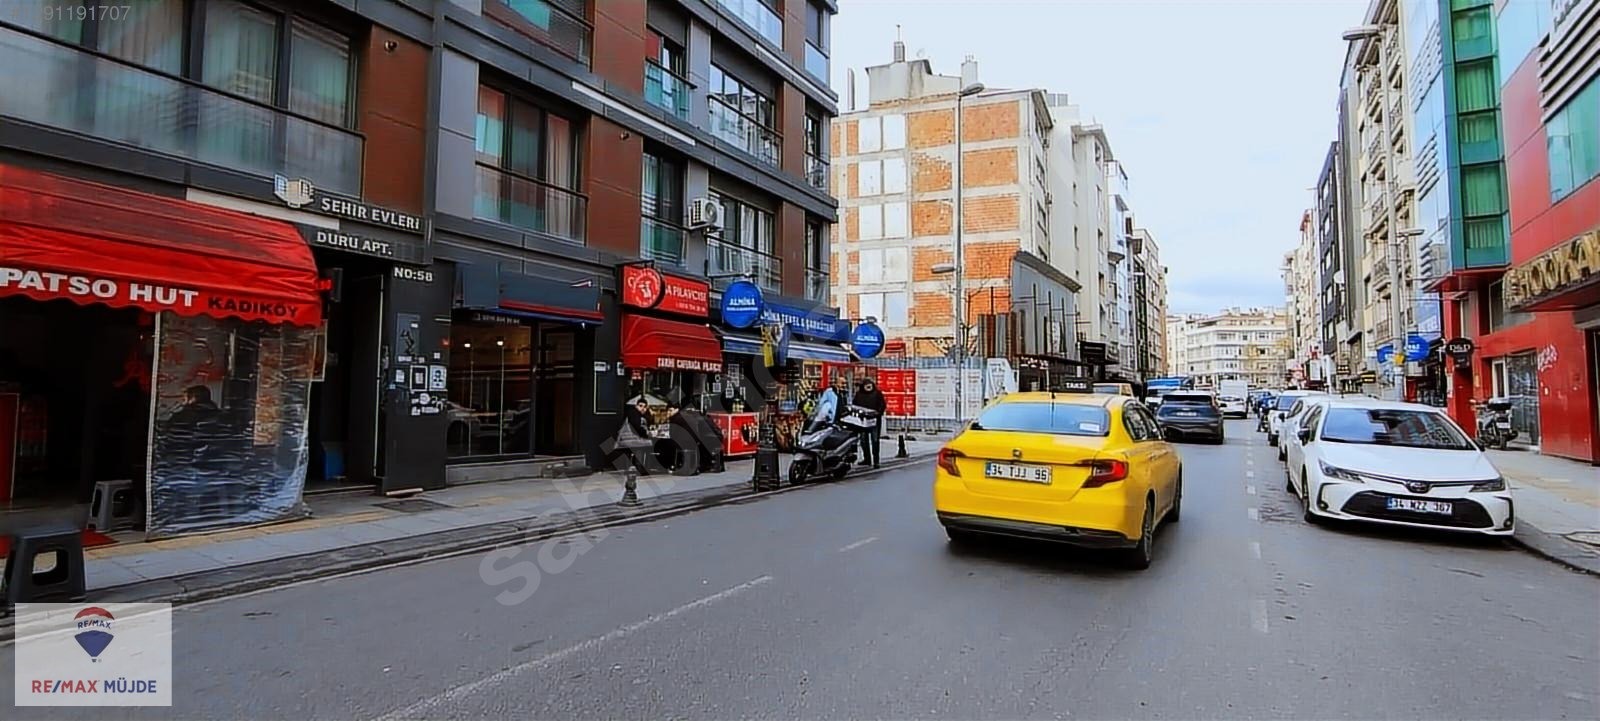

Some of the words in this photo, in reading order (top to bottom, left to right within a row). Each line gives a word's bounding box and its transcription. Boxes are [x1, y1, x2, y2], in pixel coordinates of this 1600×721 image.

[316, 231, 359, 249] DURU
[361, 240, 393, 256] APT.
[0, 267, 118, 298] PATSO
[129, 283, 199, 307] HUT
[991, 464, 1003, 476] 34
